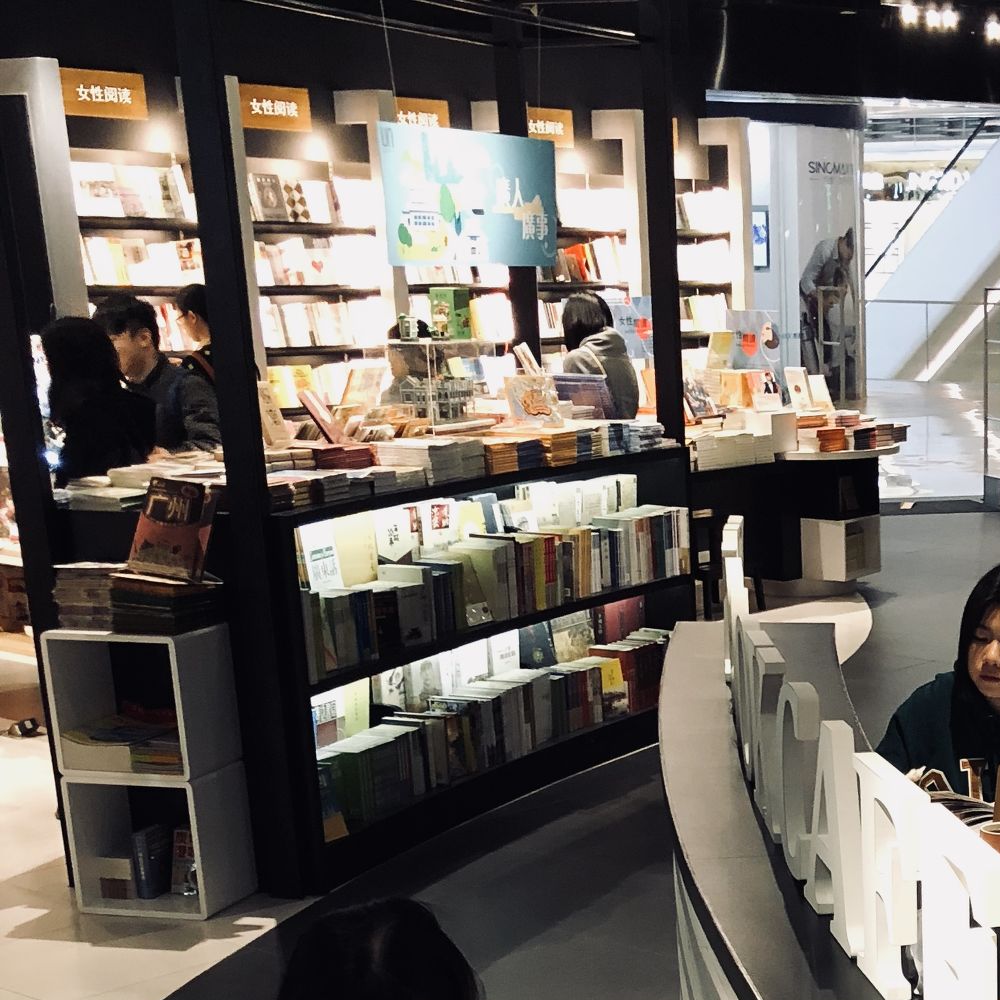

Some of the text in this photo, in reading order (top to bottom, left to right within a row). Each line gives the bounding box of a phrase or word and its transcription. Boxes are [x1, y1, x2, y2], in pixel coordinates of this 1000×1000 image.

[76, 84, 132, 105] 女性阅读
[249, 98, 299, 118] 女性阅读
[528, 119, 565, 136] 女性阅读
